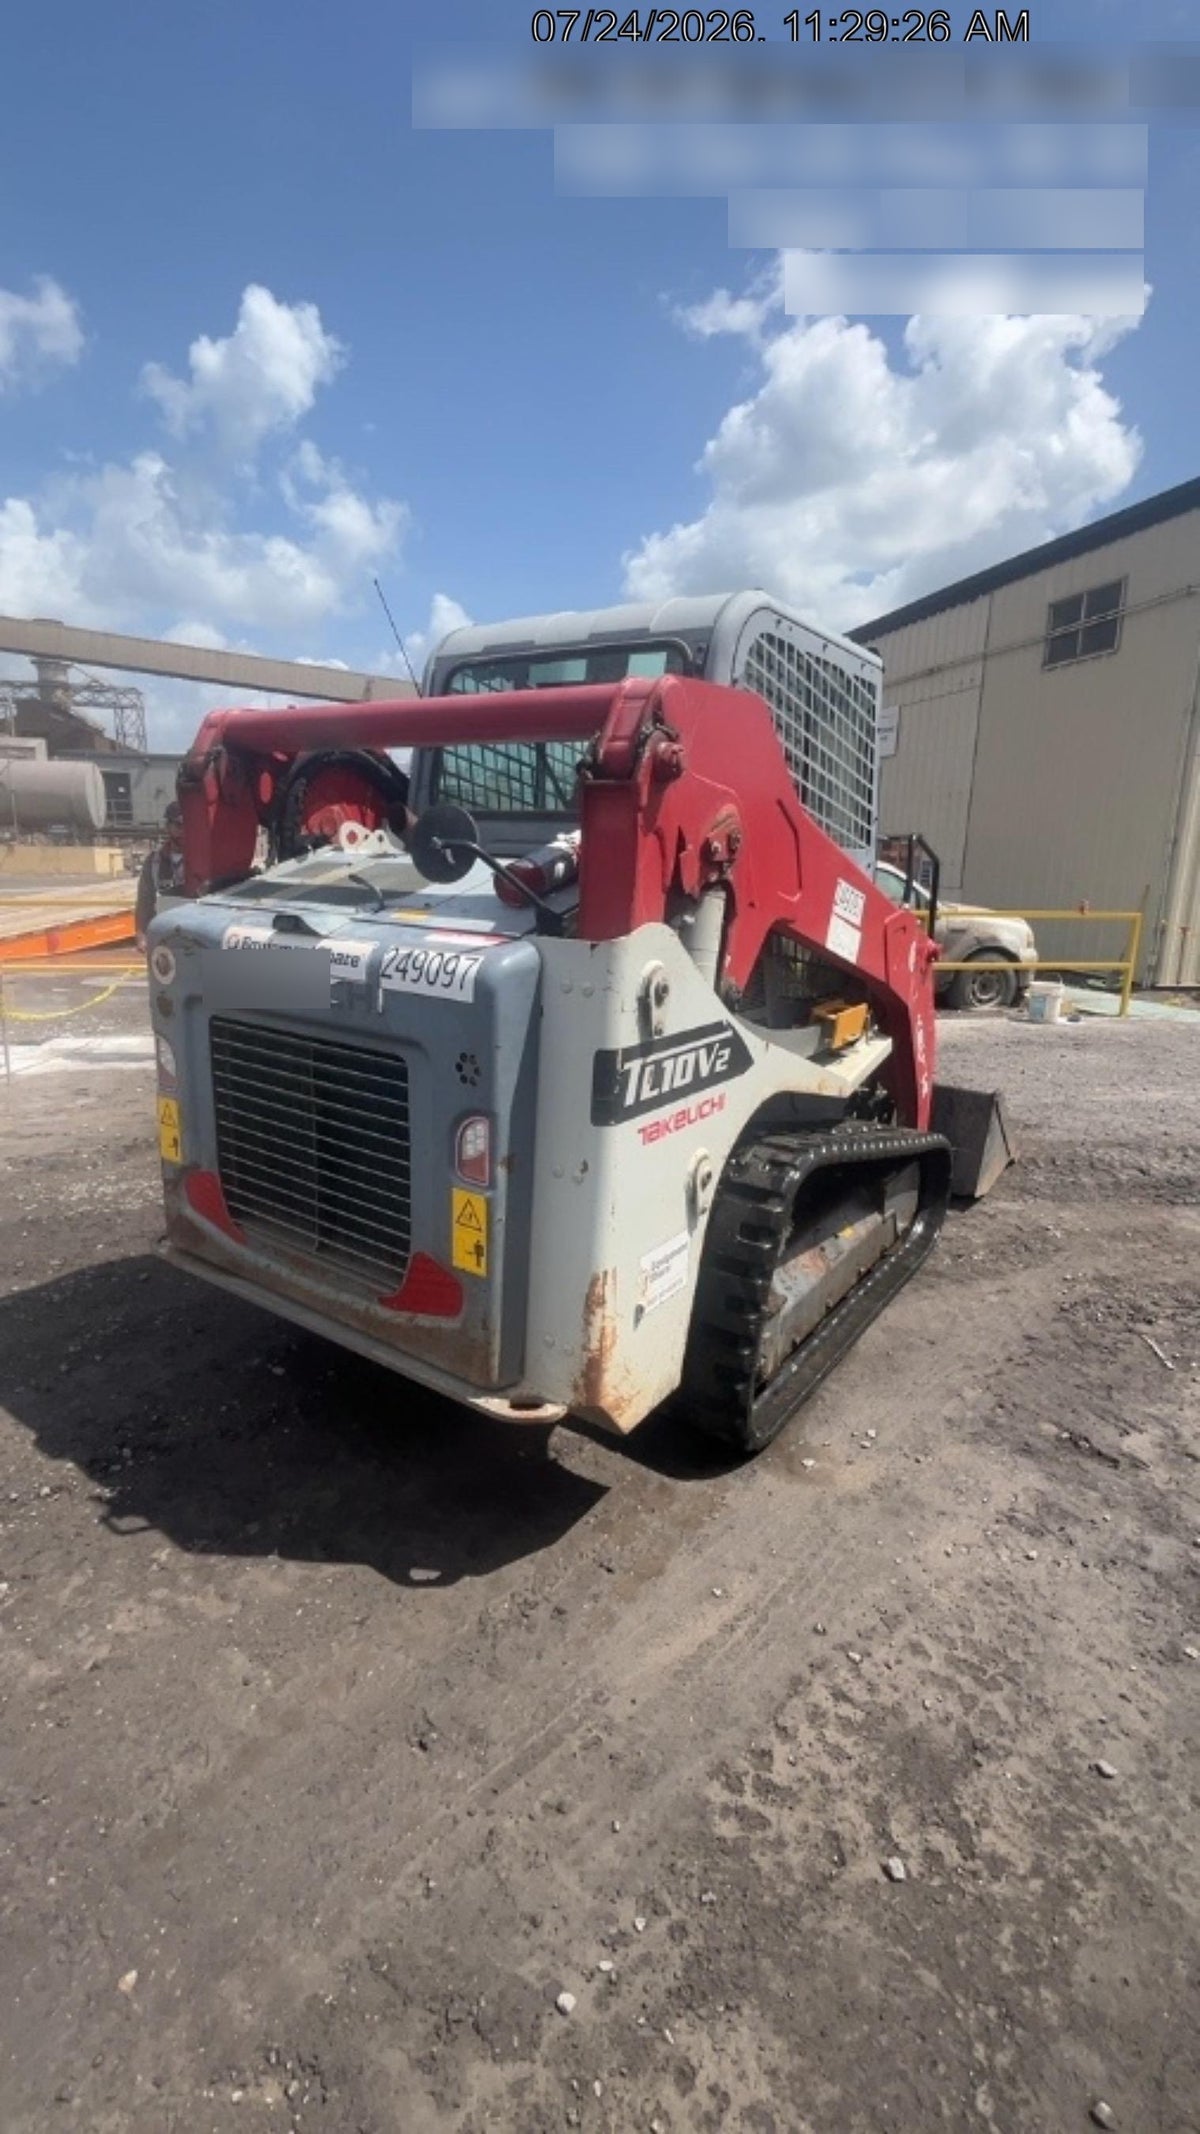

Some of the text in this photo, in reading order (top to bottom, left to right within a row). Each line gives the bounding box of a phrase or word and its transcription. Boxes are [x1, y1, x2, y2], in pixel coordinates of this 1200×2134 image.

[380, 947, 479, 991] 249097
[623, 1043, 731, 1107] TL10V2
[638, 1093, 727, 1146] TAKEUCHI
